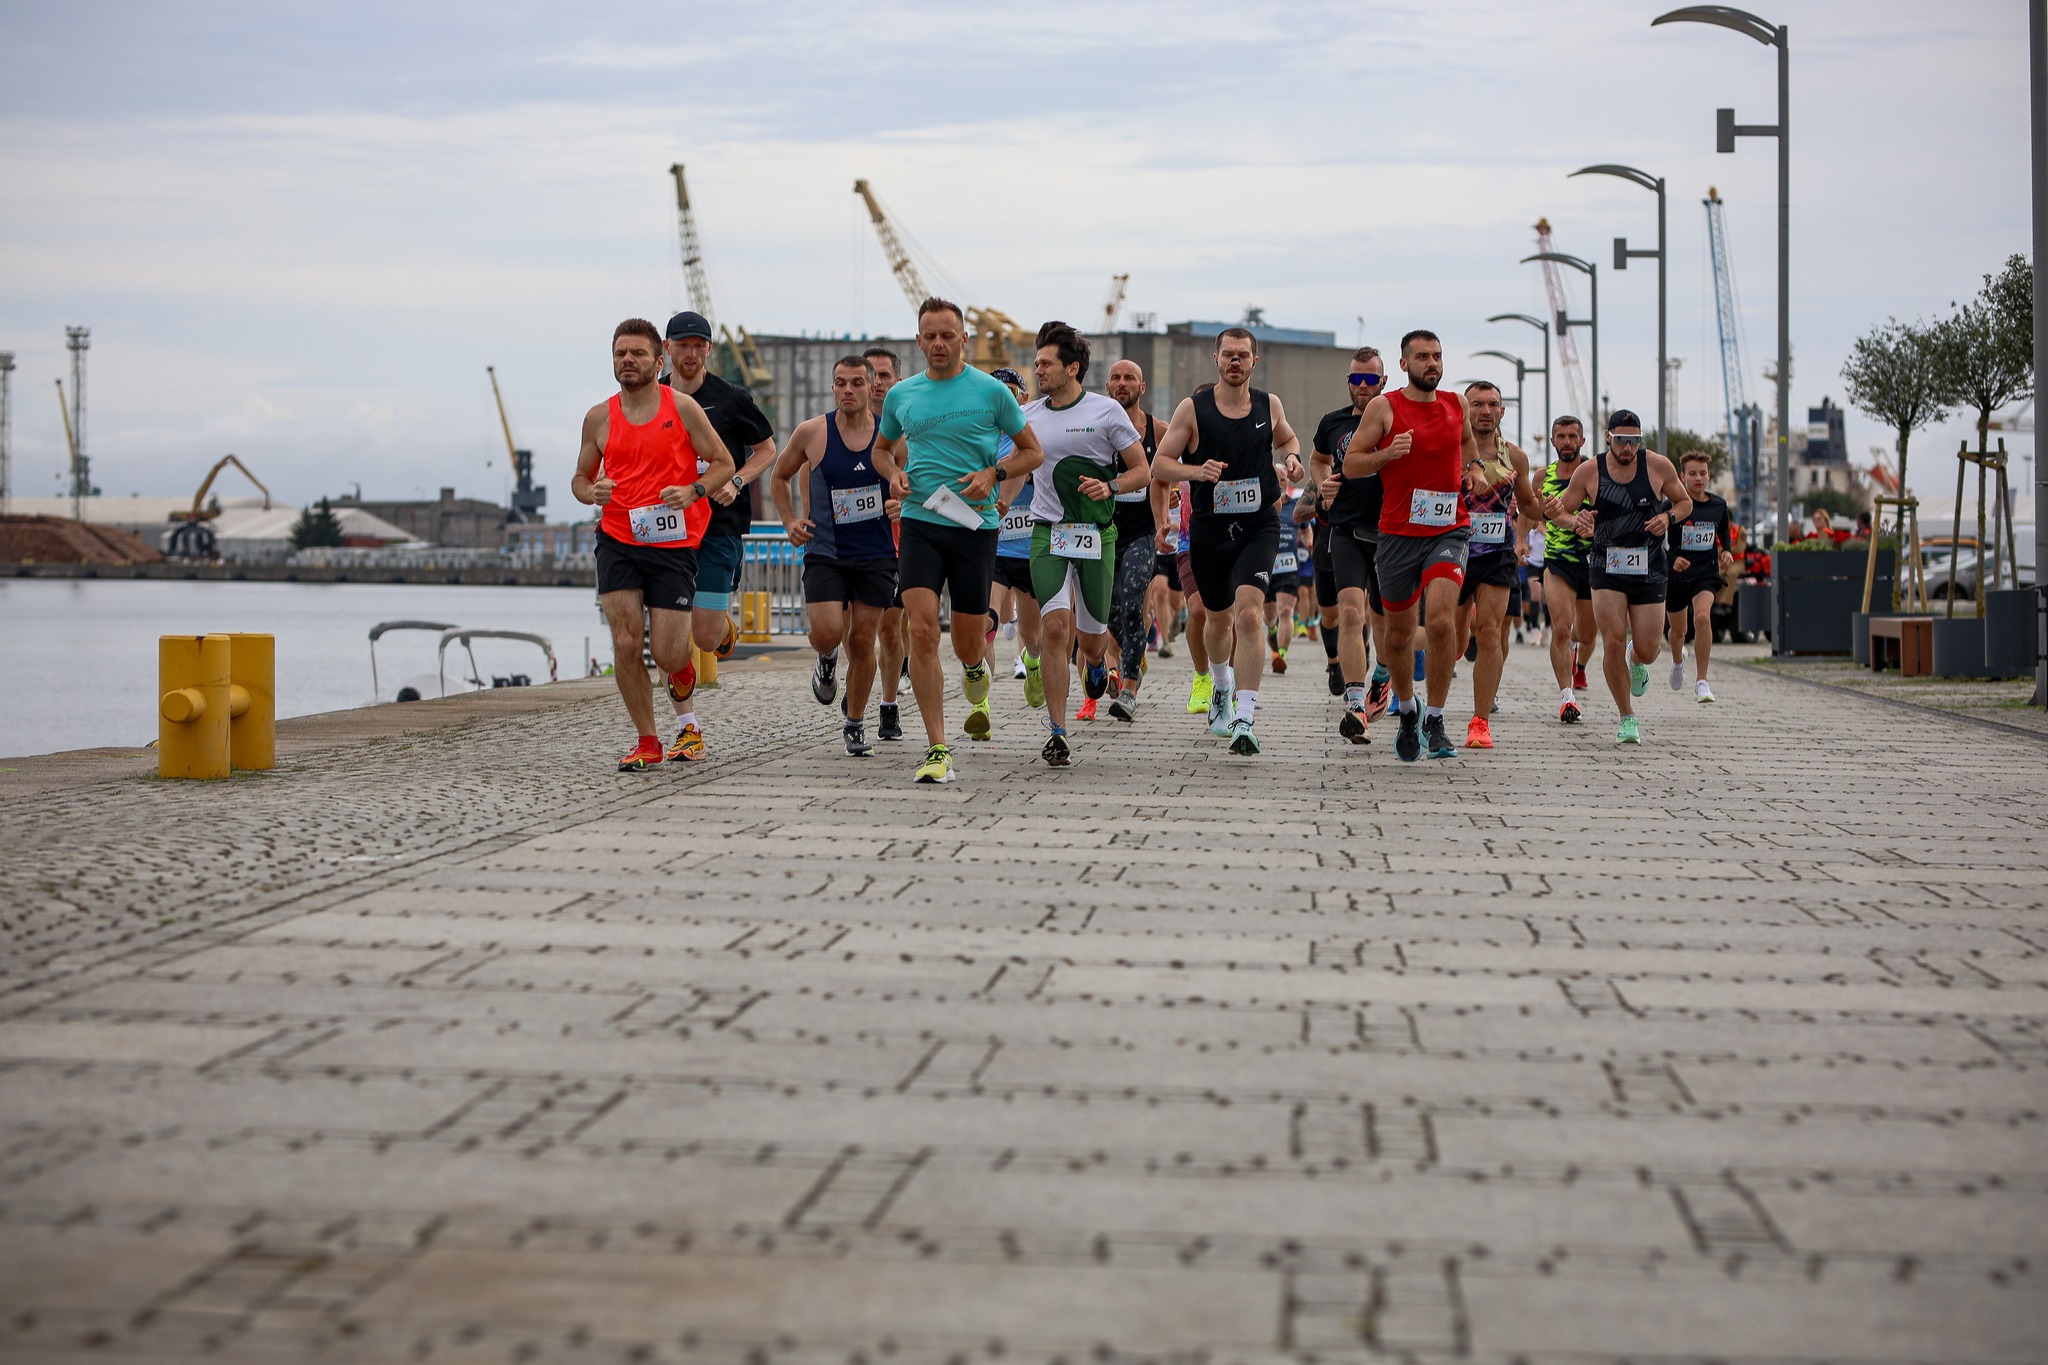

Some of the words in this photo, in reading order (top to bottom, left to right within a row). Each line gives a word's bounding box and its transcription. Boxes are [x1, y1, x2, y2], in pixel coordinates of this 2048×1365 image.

[1234, 489, 1256, 504] 119
[856, 496, 876, 512] 98
[1434, 503, 1452, 516] 94
[656, 515, 677, 531] 90
[1005, 515, 1033, 530] 308
[1481, 522, 1503, 535] 377
[1074, 534, 1093, 549] 73
[1695, 533, 1714, 543] 347
[1280, 558, 1294, 567] 147
[1626, 554, 1640, 567] 21
